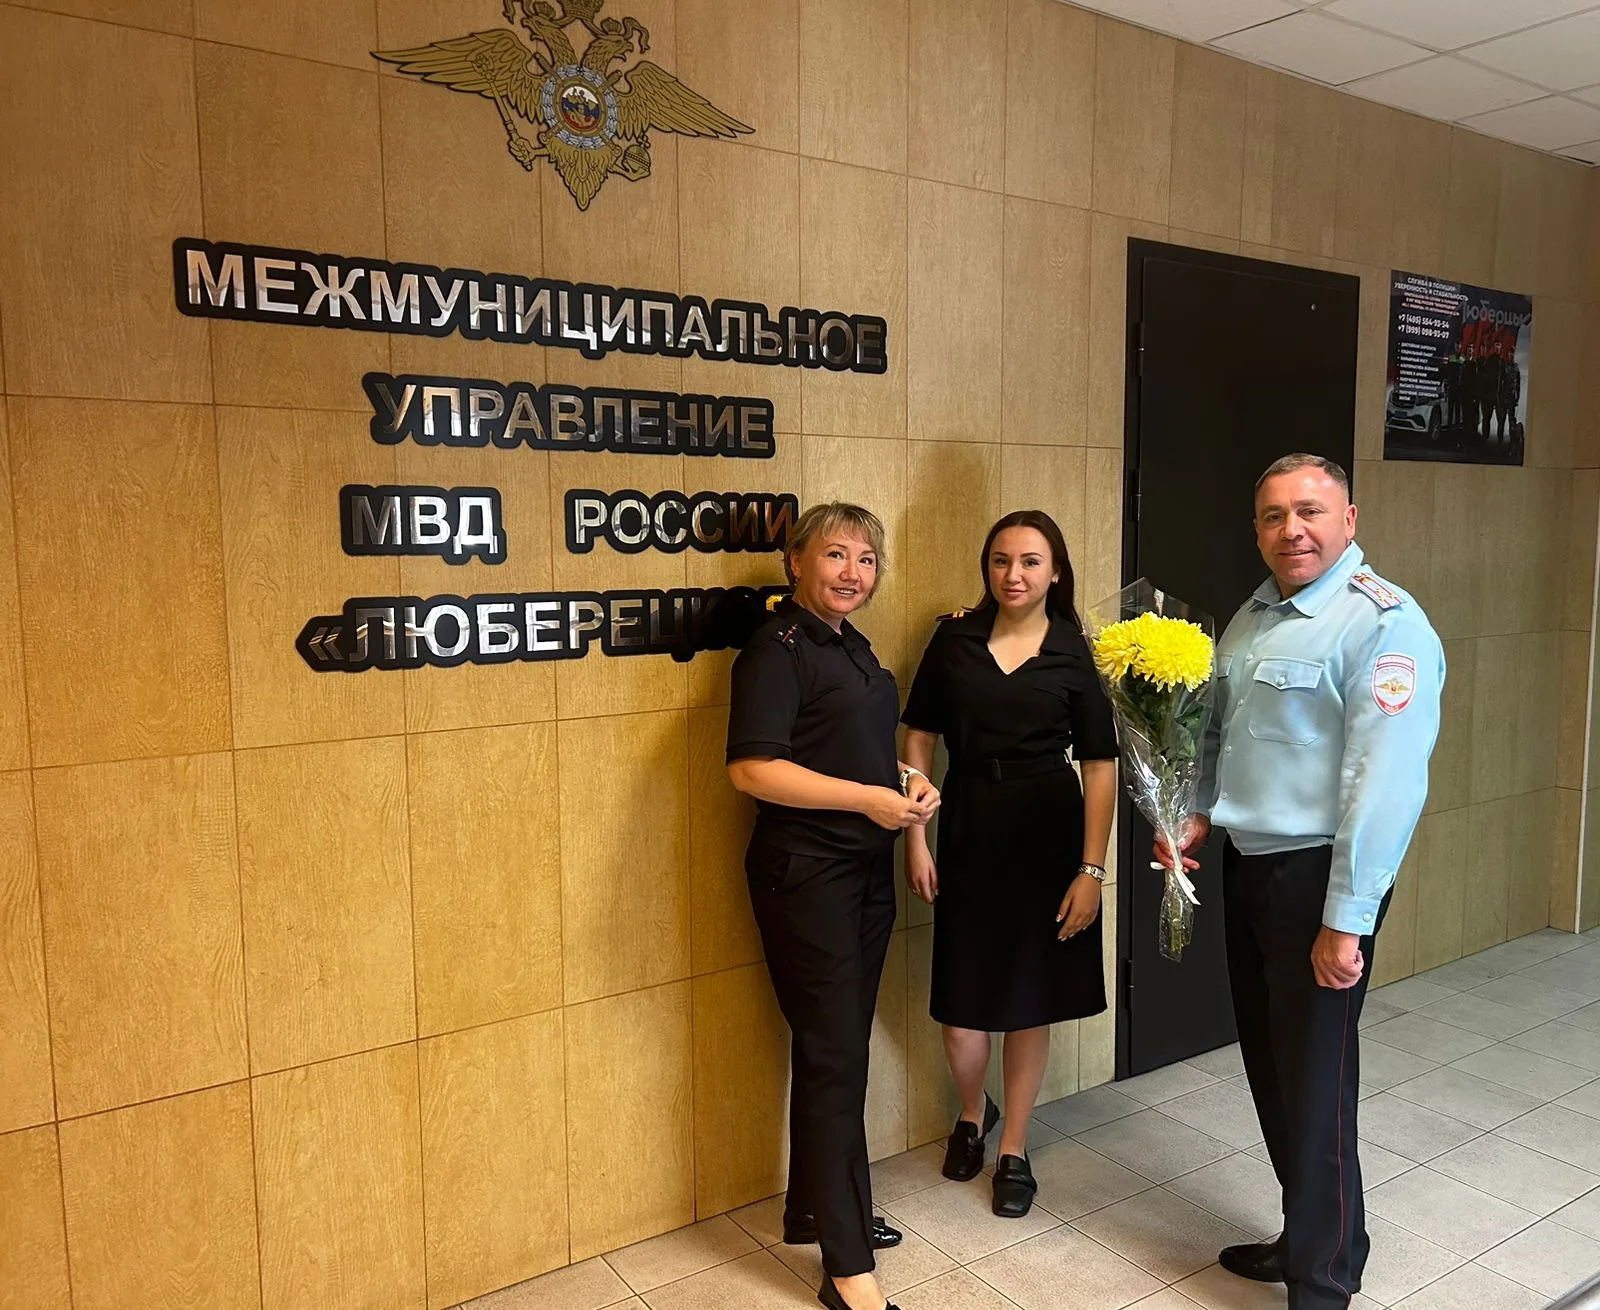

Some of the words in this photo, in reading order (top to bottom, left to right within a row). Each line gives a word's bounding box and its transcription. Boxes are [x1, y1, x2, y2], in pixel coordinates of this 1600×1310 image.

[185, 248, 884, 367] МЕЖМУНИЦИПАЛЬНОЕ
[373, 382, 770, 450] УПРАВЛЕНИЕ
[352, 494, 499, 555] МВД
[574, 498, 794, 544] РОССИИ
